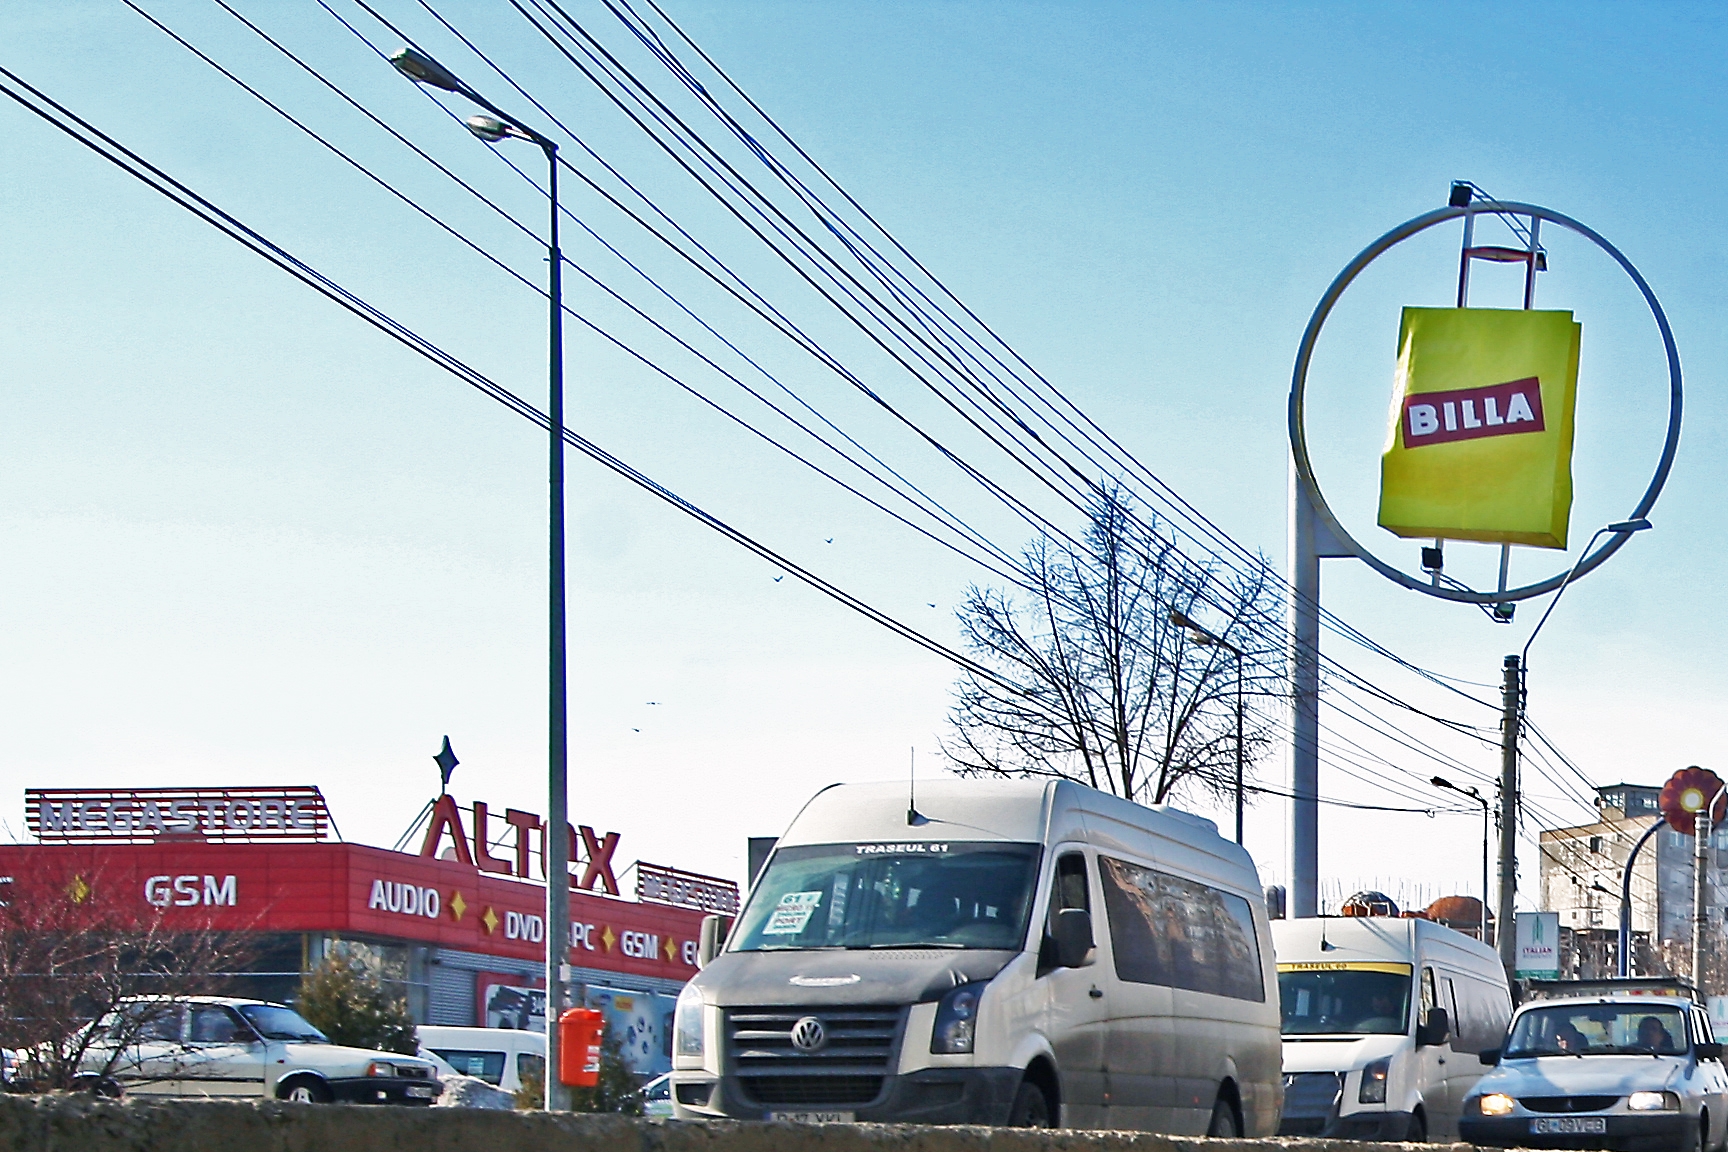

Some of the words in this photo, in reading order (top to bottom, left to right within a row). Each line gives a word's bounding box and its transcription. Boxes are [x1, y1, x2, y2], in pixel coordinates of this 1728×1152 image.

[1408, 392, 1535, 436] BILLA
[38, 799, 317, 834] MEGASTORE
[855, 843, 926, 854] TRASEUL
[929, 843, 949, 853] 61
[144, 874, 238, 907] GSM
[368, 879, 441, 919] AUDIO
[504, 911, 544, 944] DVD
[570, 921, 596, 951] PC
[620, 930, 659, 960] GSM
